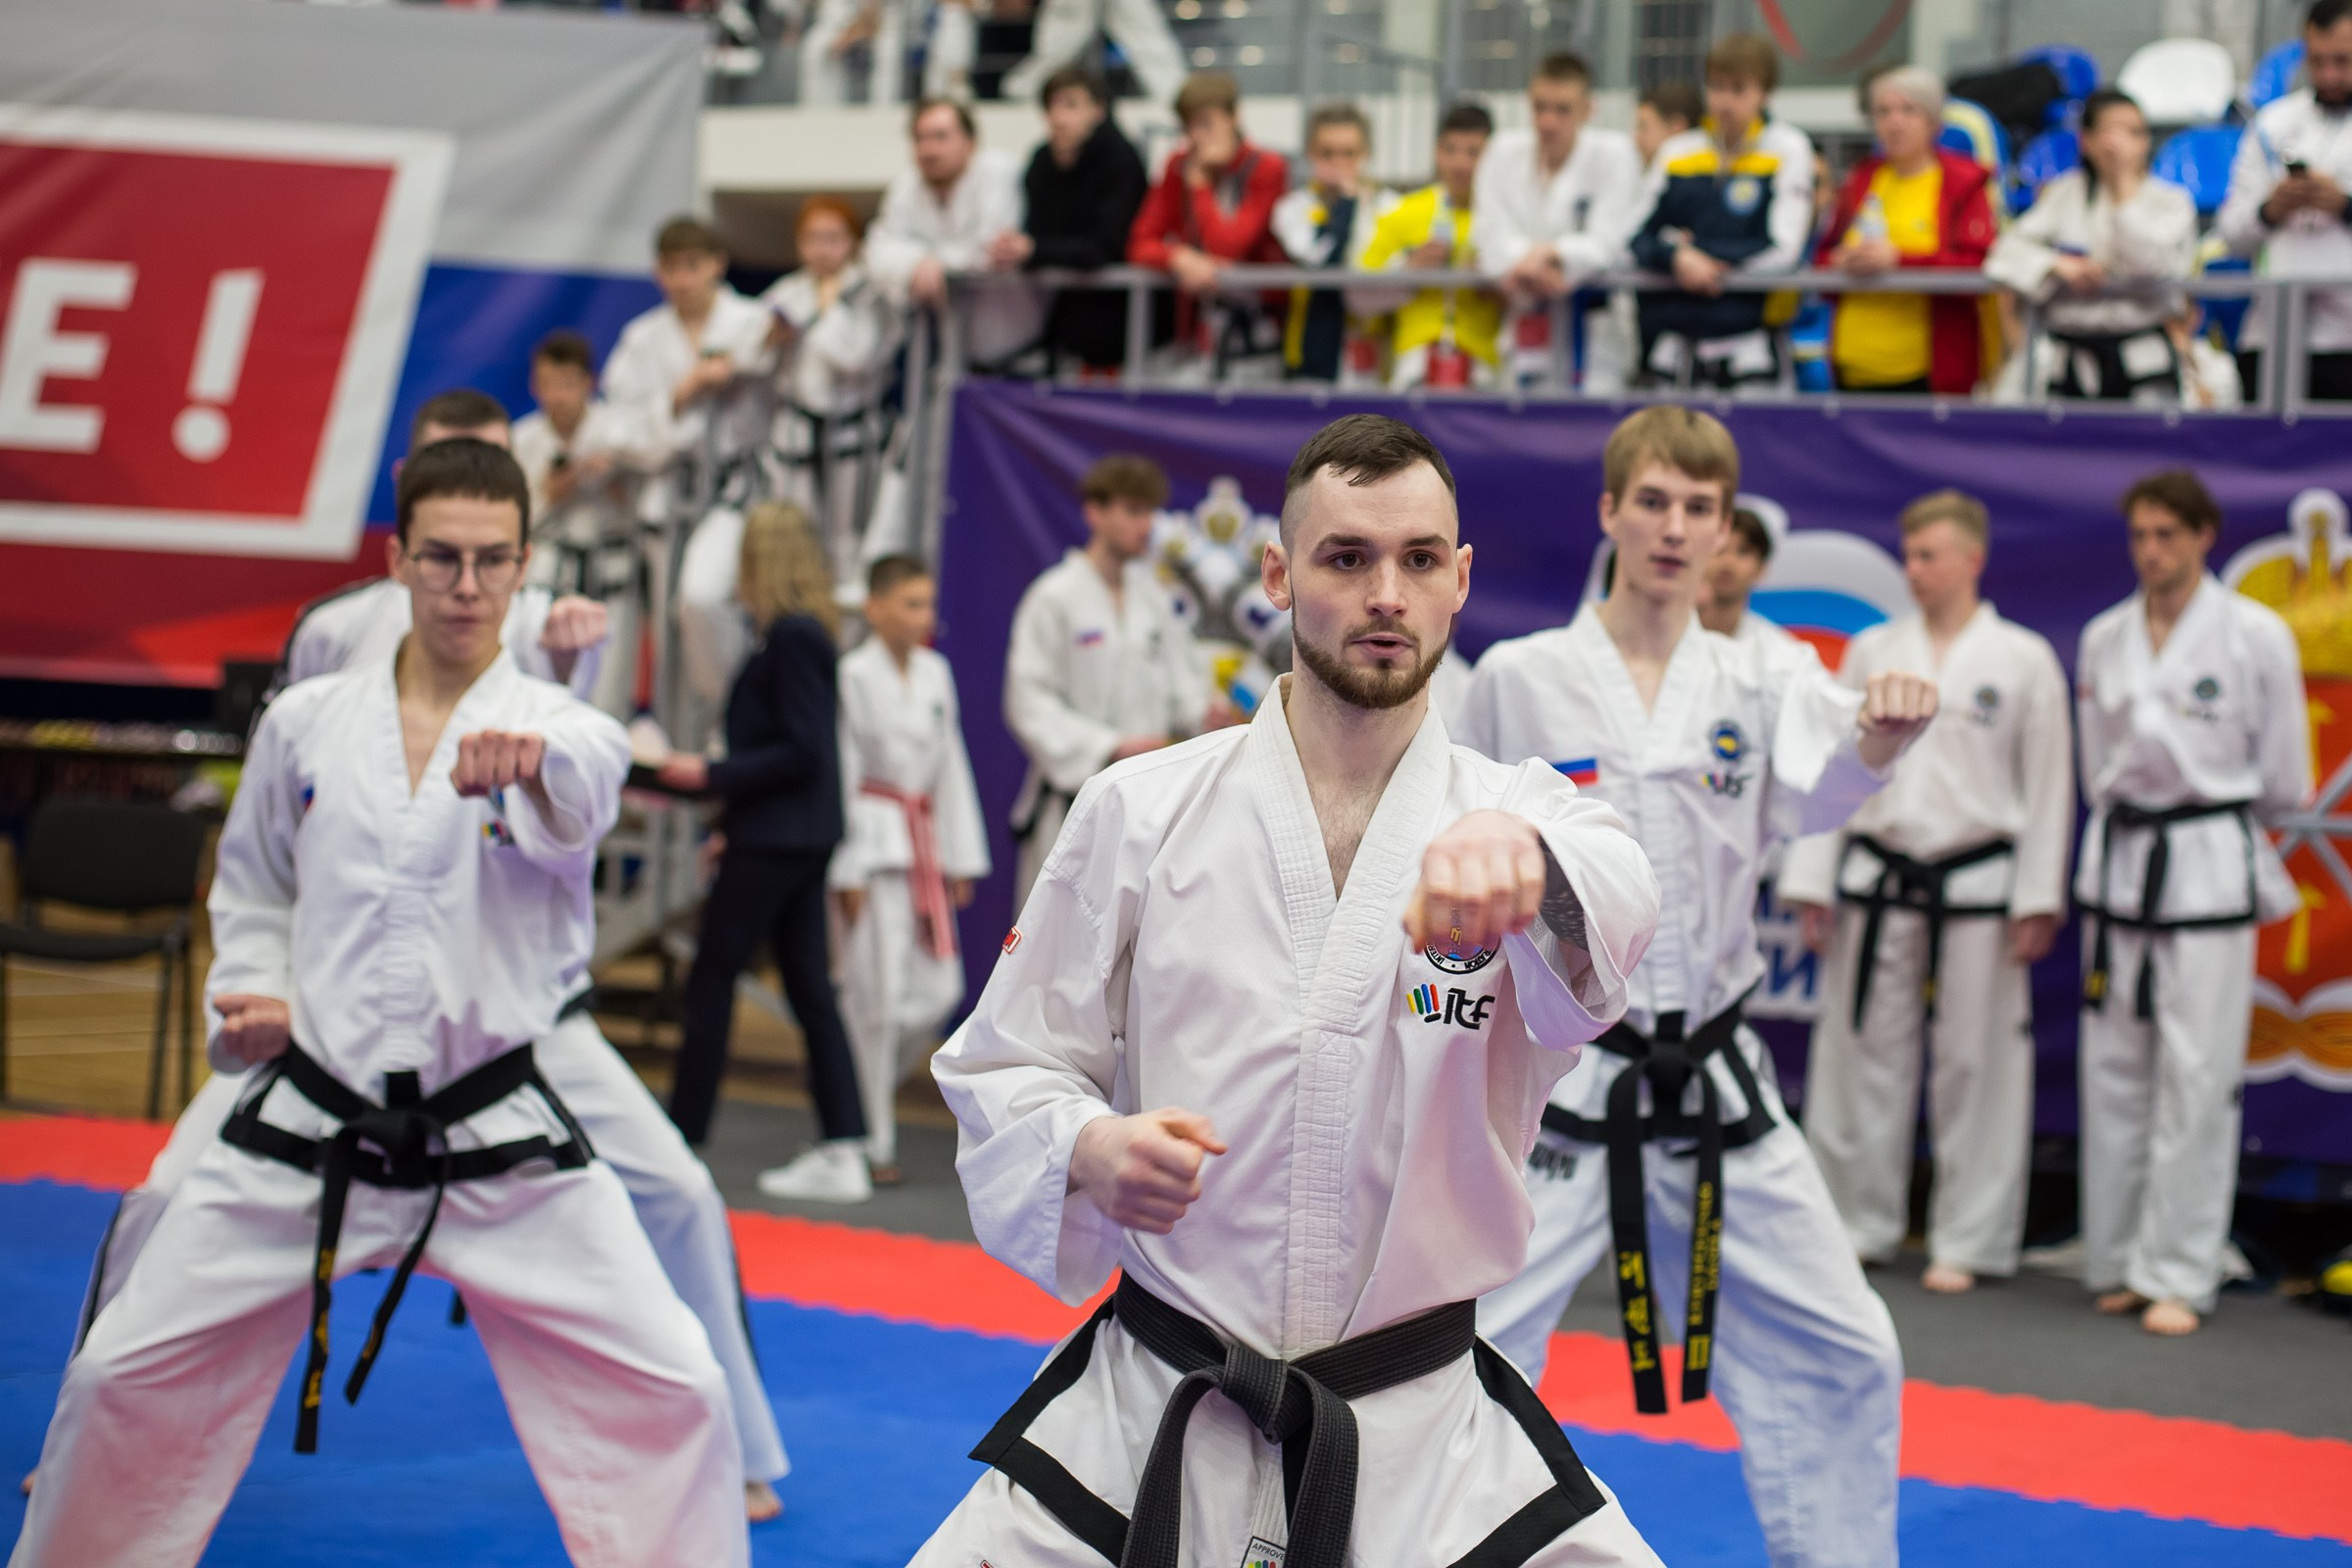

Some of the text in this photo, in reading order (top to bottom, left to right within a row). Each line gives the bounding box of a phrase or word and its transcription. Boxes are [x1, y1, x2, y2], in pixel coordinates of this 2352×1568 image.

[1426, 944, 1446, 965] INTER
[1464, 949, 1492, 970] RATION
[1252, 1543, 1287, 1561] APPROVE
